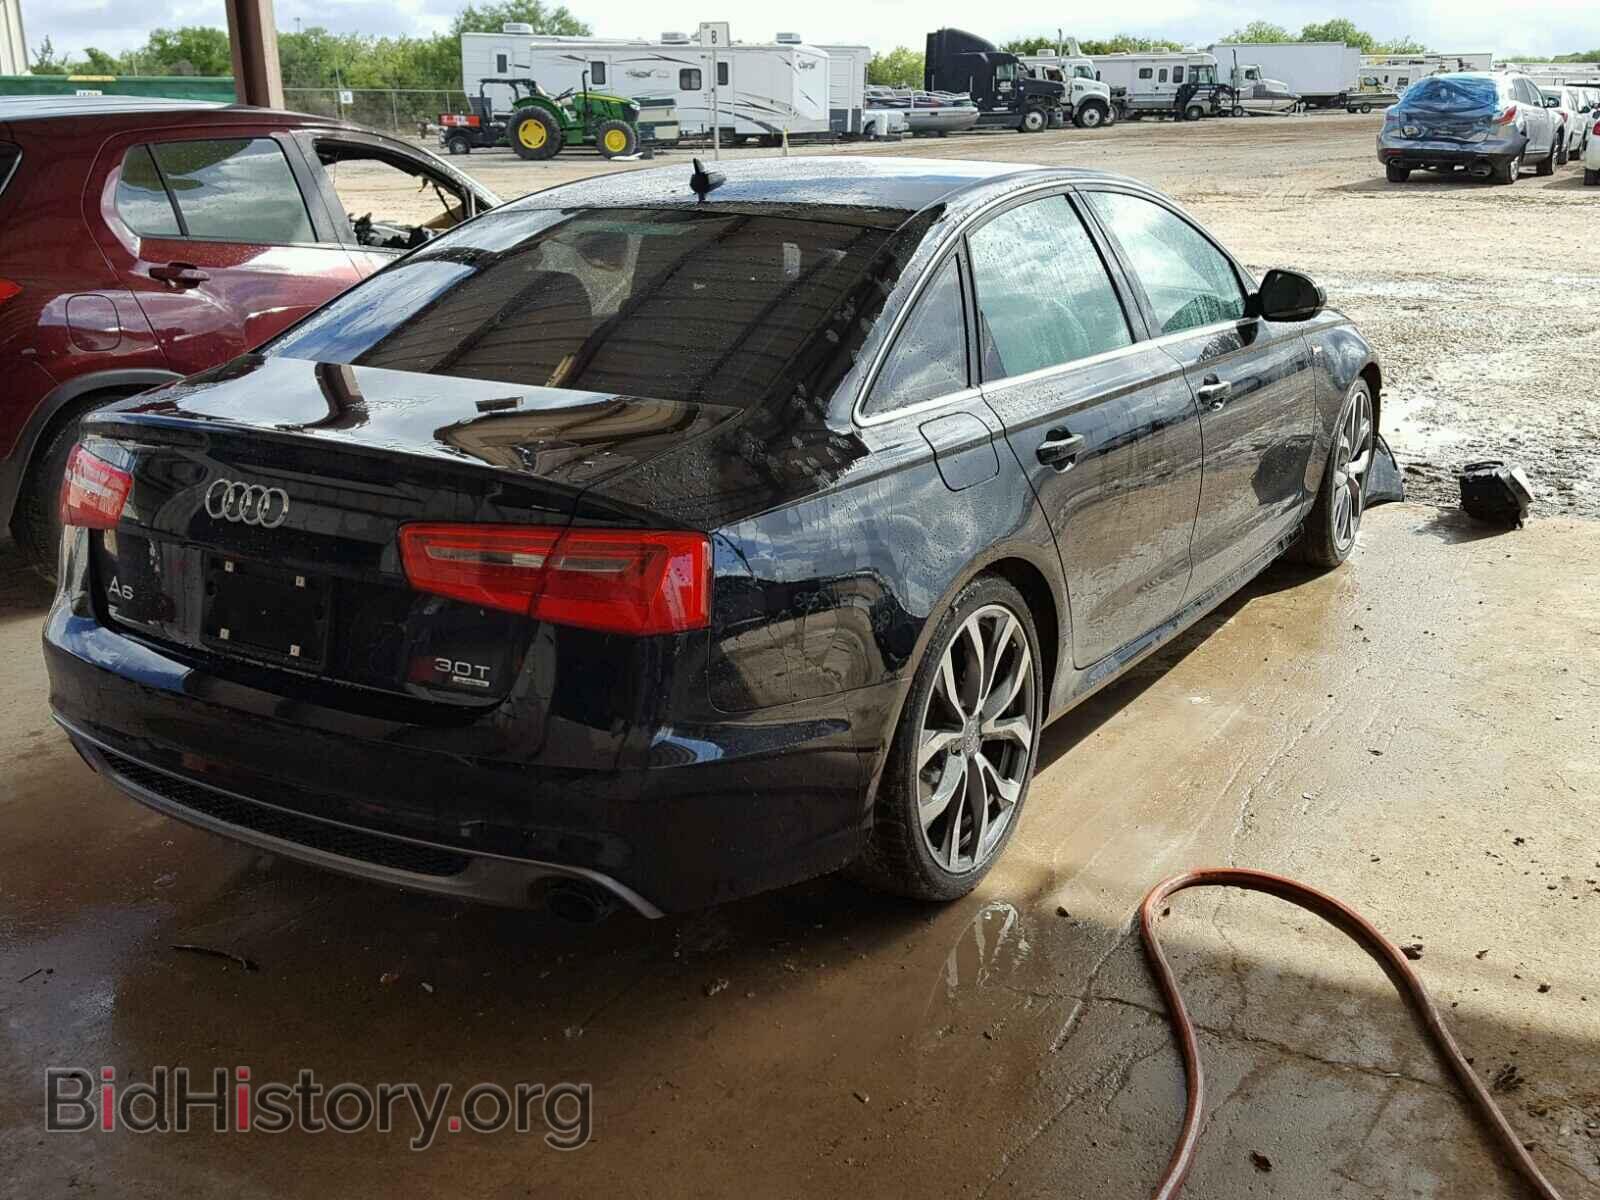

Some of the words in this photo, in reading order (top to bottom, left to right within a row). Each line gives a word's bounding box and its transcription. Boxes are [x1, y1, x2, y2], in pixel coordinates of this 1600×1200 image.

[711, 30, 718, 45] B
[108, 575, 134, 600] A6
[434, 657, 491, 680] 3.0T
